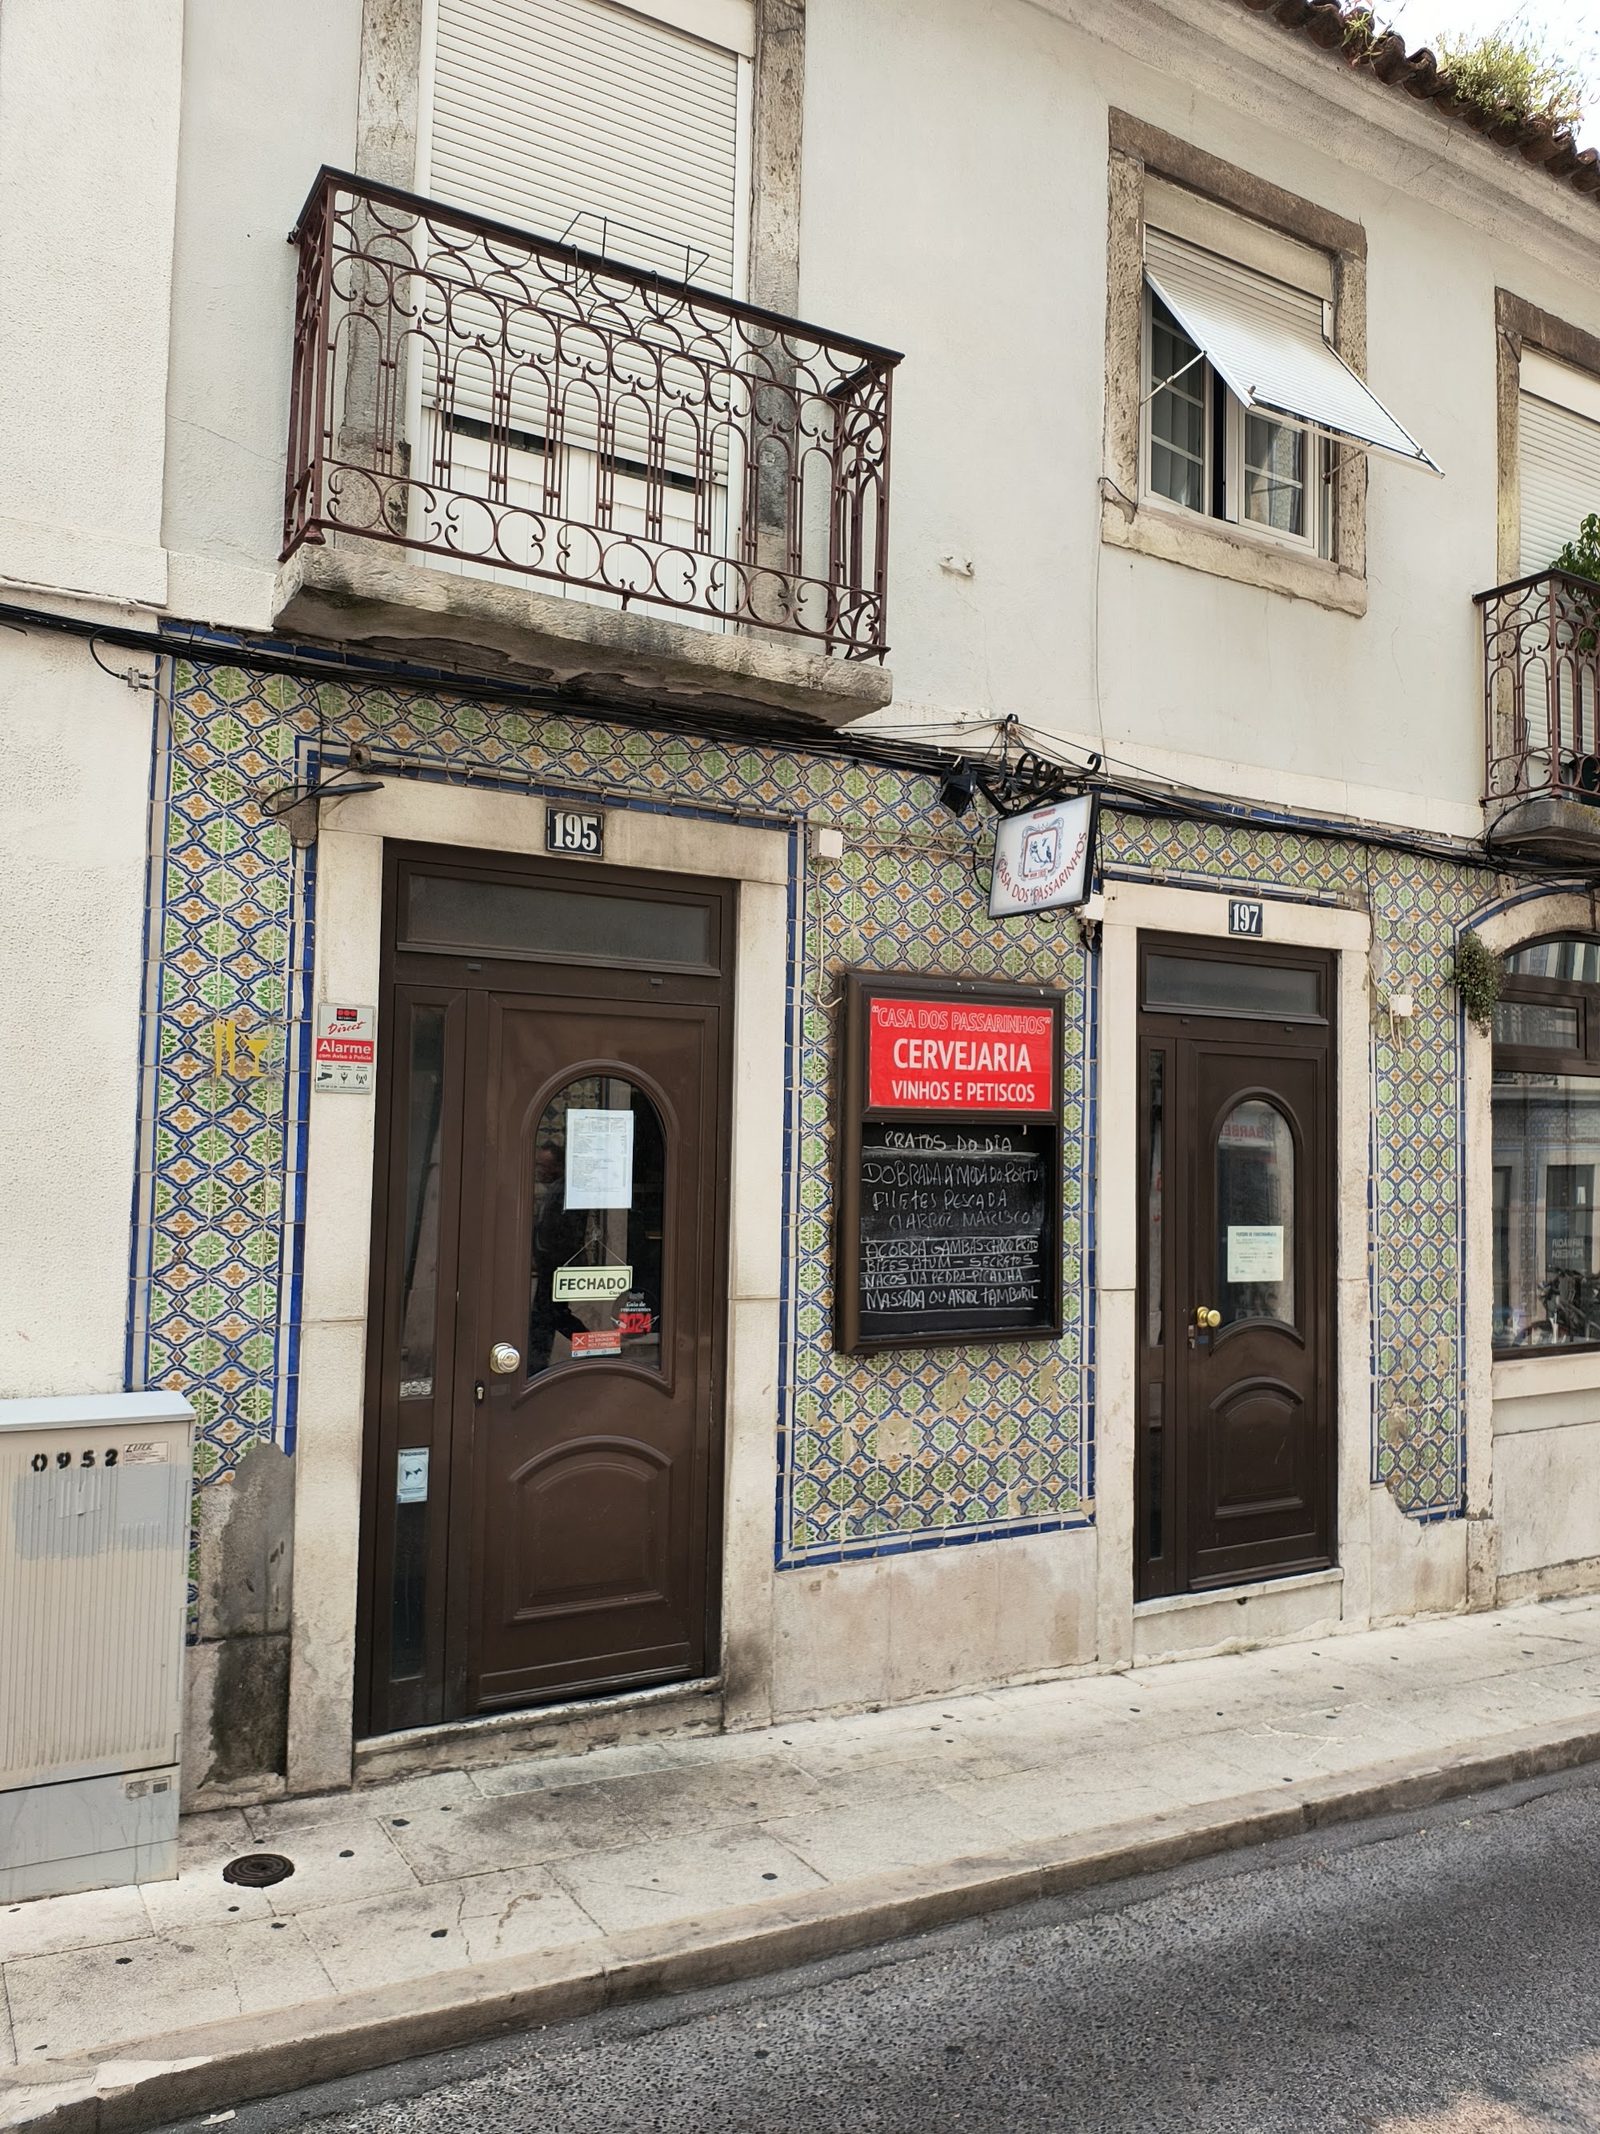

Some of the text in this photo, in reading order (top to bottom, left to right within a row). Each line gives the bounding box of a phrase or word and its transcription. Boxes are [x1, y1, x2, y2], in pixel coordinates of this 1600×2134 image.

[554, 813, 597, 851] 195
[998, 832, 1087, 903] CASA DOS PASSARINHOS
[1233, 903, 1259, 932] 197
[918, 1009, 949, 1030] DOS
[319, 1040, 371, 1054] Alarme
[893, 1038, 1032, 1073] CERVEJARIA
[892, 1080, 1035, 1103] VINHOS E PETISCOS
[885, 1130, 947, 1151] PRATOS
[956, 1134, 978, 1152] DO
[861, 1160, 942, 1188] DOBRADA
[559, 1277, 627, 1290] FECHADO
[864, 1274, 907, 1289] NACOS
[866, 1290, 925, 1310] MASSADA
[929, 1291, 946, 1304] OU
[618, 1313, 652, 1333] 2024
[31, 1449, 118, 1472] 0952
